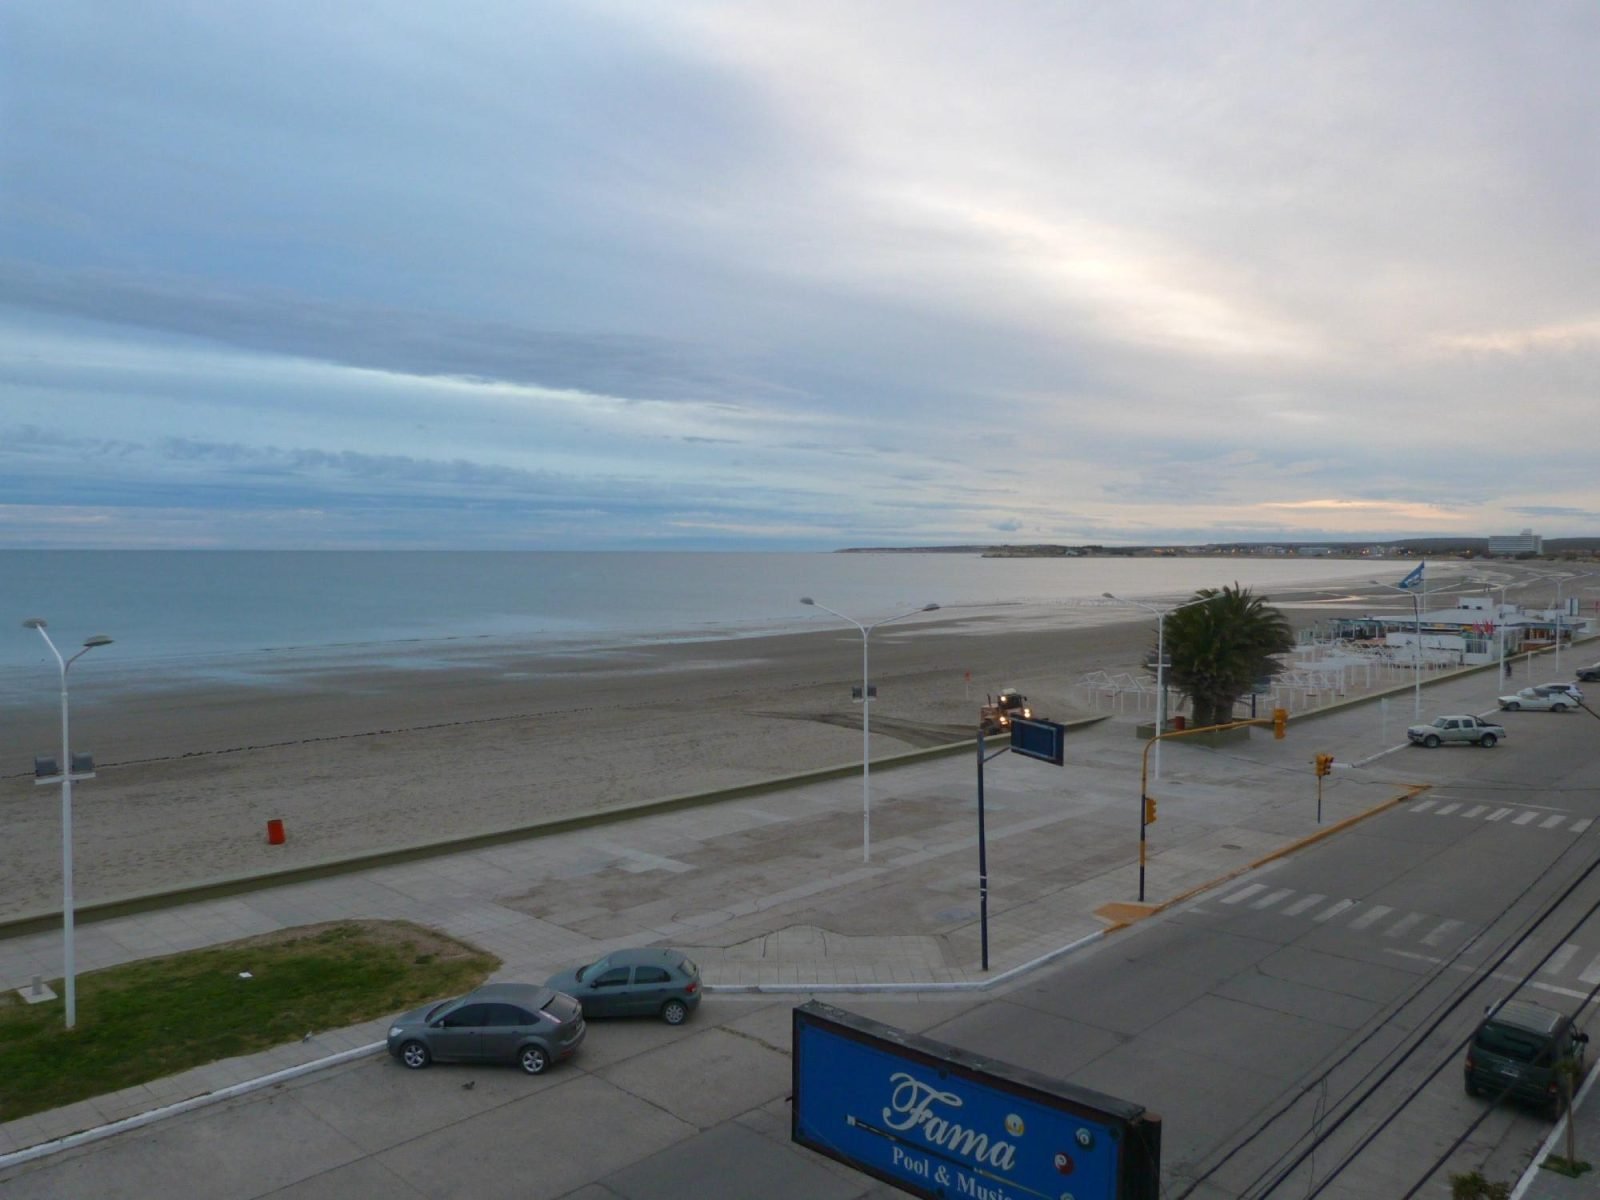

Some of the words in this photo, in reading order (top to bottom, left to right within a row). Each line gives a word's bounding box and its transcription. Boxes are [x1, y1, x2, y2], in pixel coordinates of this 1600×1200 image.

[883, 1072, 1016, 1170] Fama
[893, 1146, 930, 1178] Pool
[934, 1165, 950, 1187] &
[957, 1172, 1013, 1200] Musi
